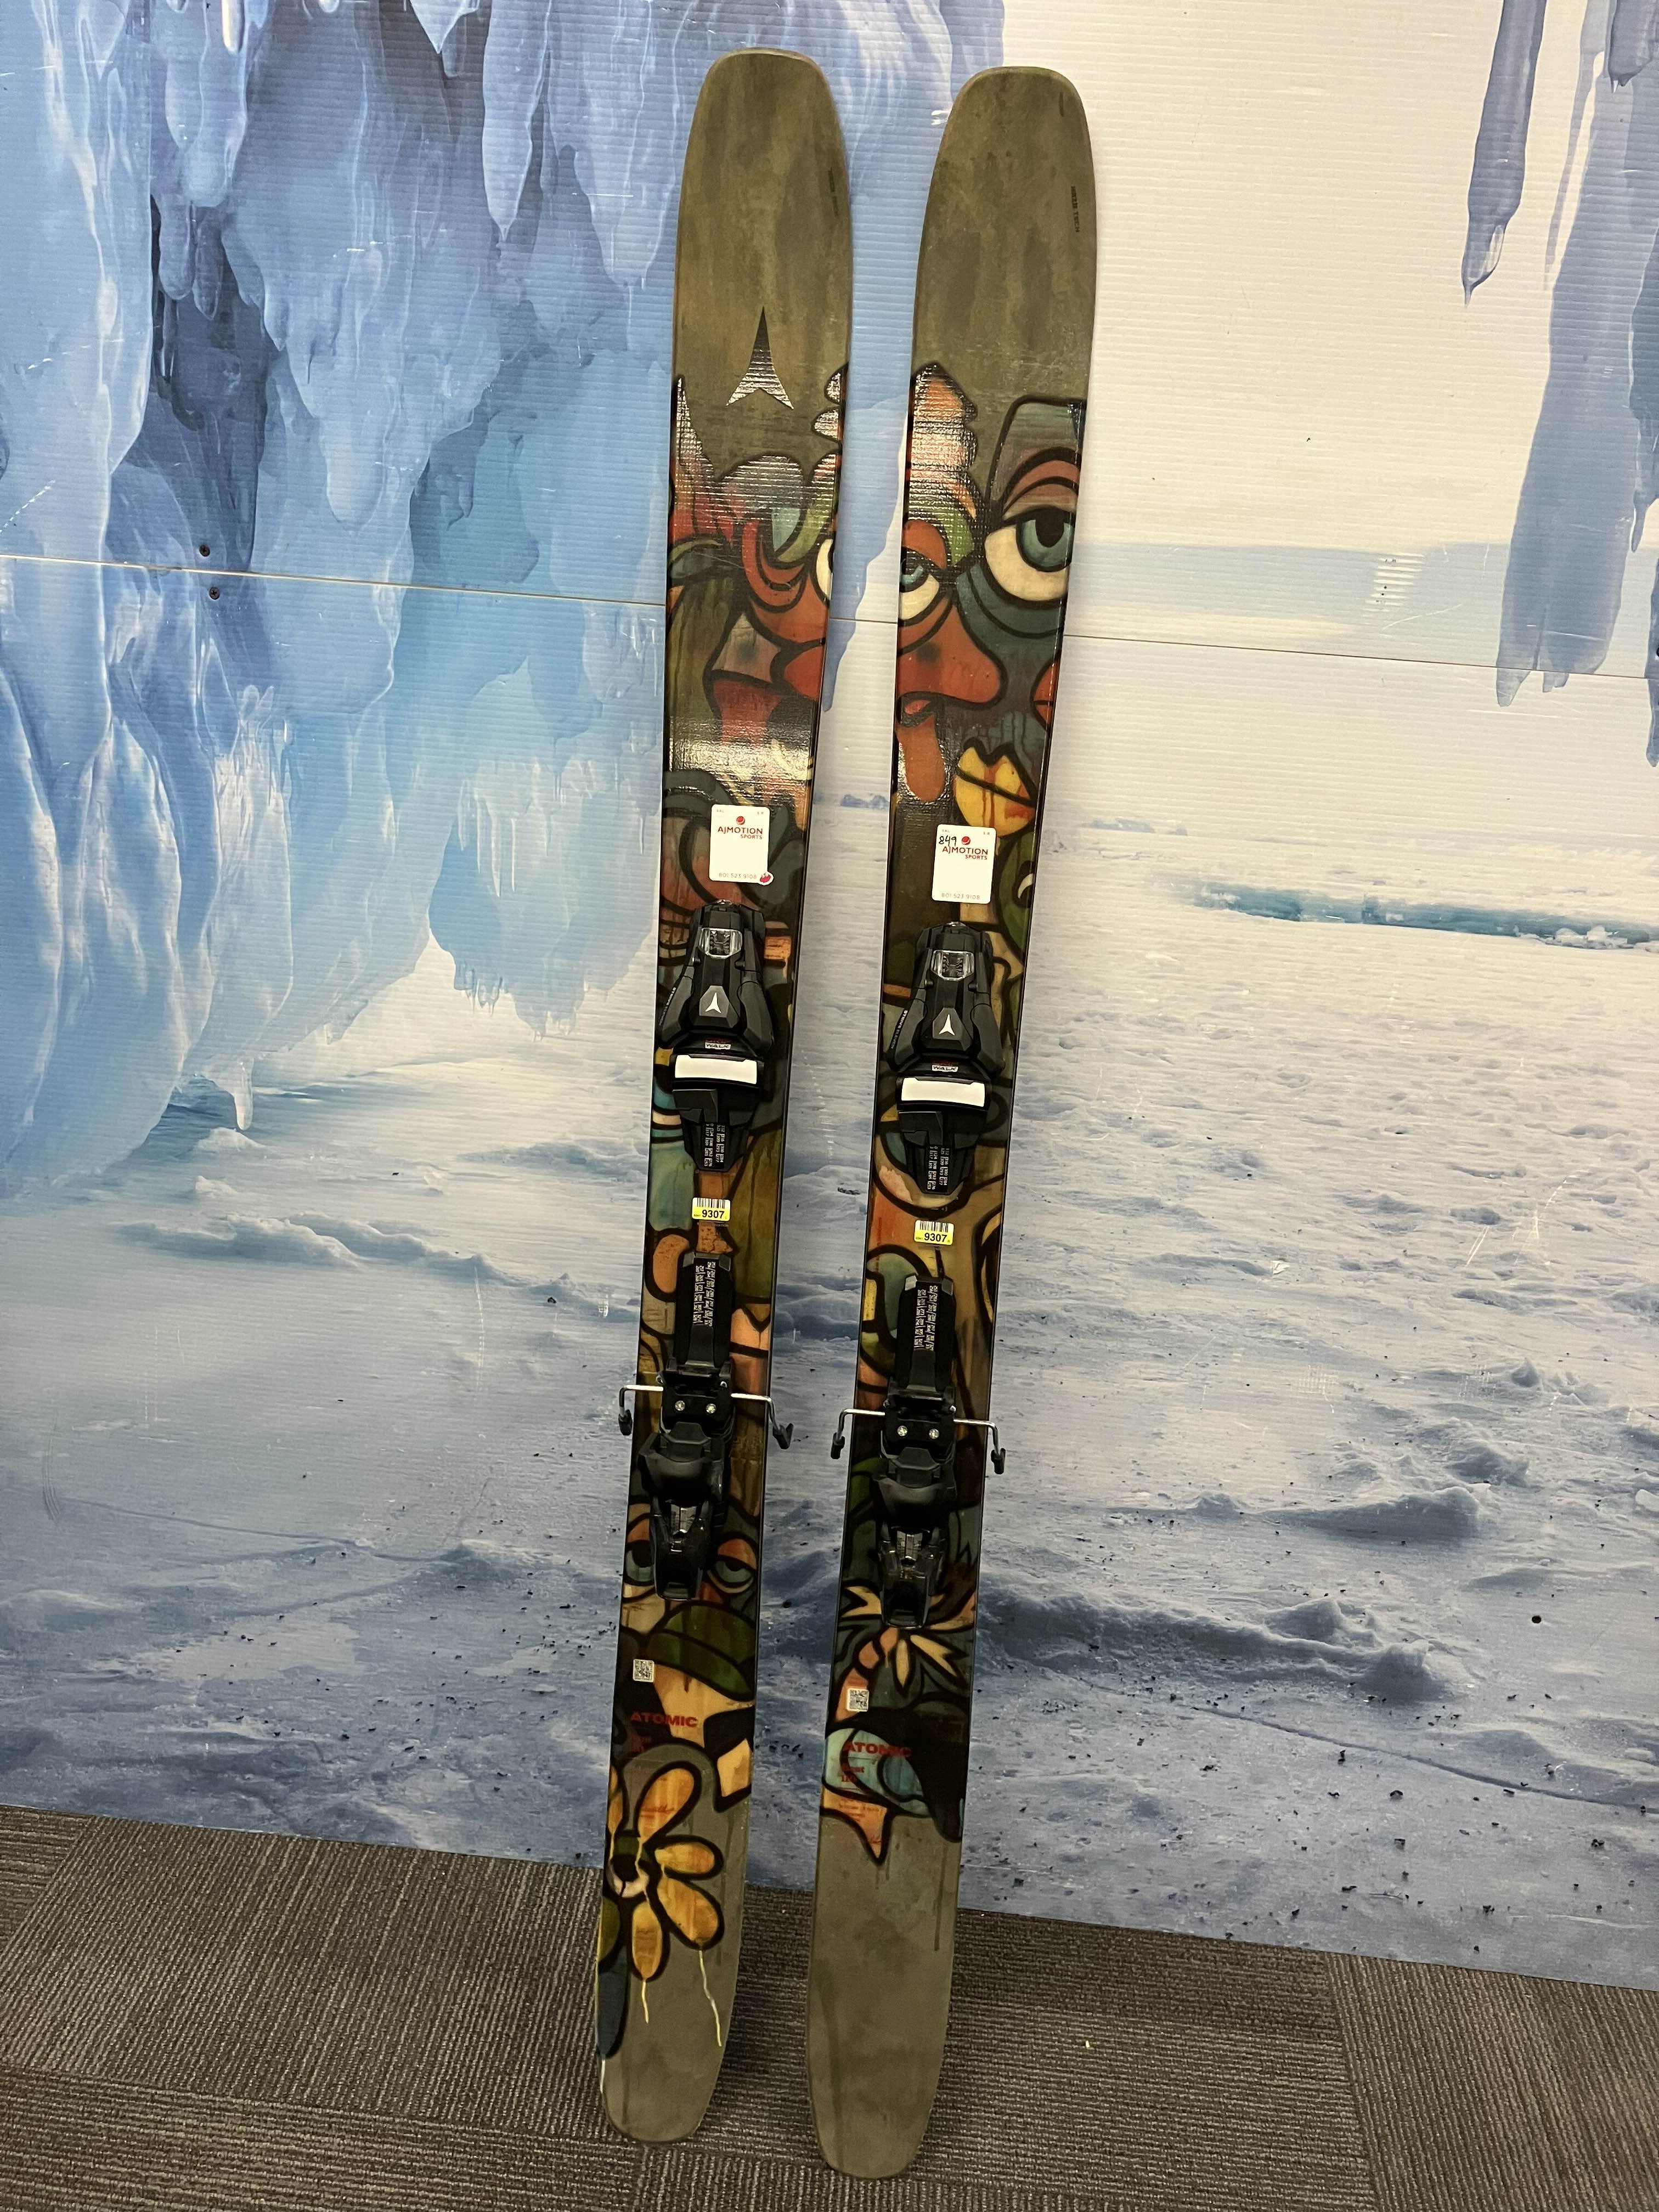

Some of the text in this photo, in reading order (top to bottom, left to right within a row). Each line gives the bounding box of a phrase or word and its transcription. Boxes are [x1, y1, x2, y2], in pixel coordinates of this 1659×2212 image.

[939, 835, 957, 847] 849
[702, 1209, 725, 1218] 9307
[924, 1232, 947, 1242] 9307
[631, 1711, 698, 1727] ATOMIC
[843, 1741, 913, 1758] ATOMIC
